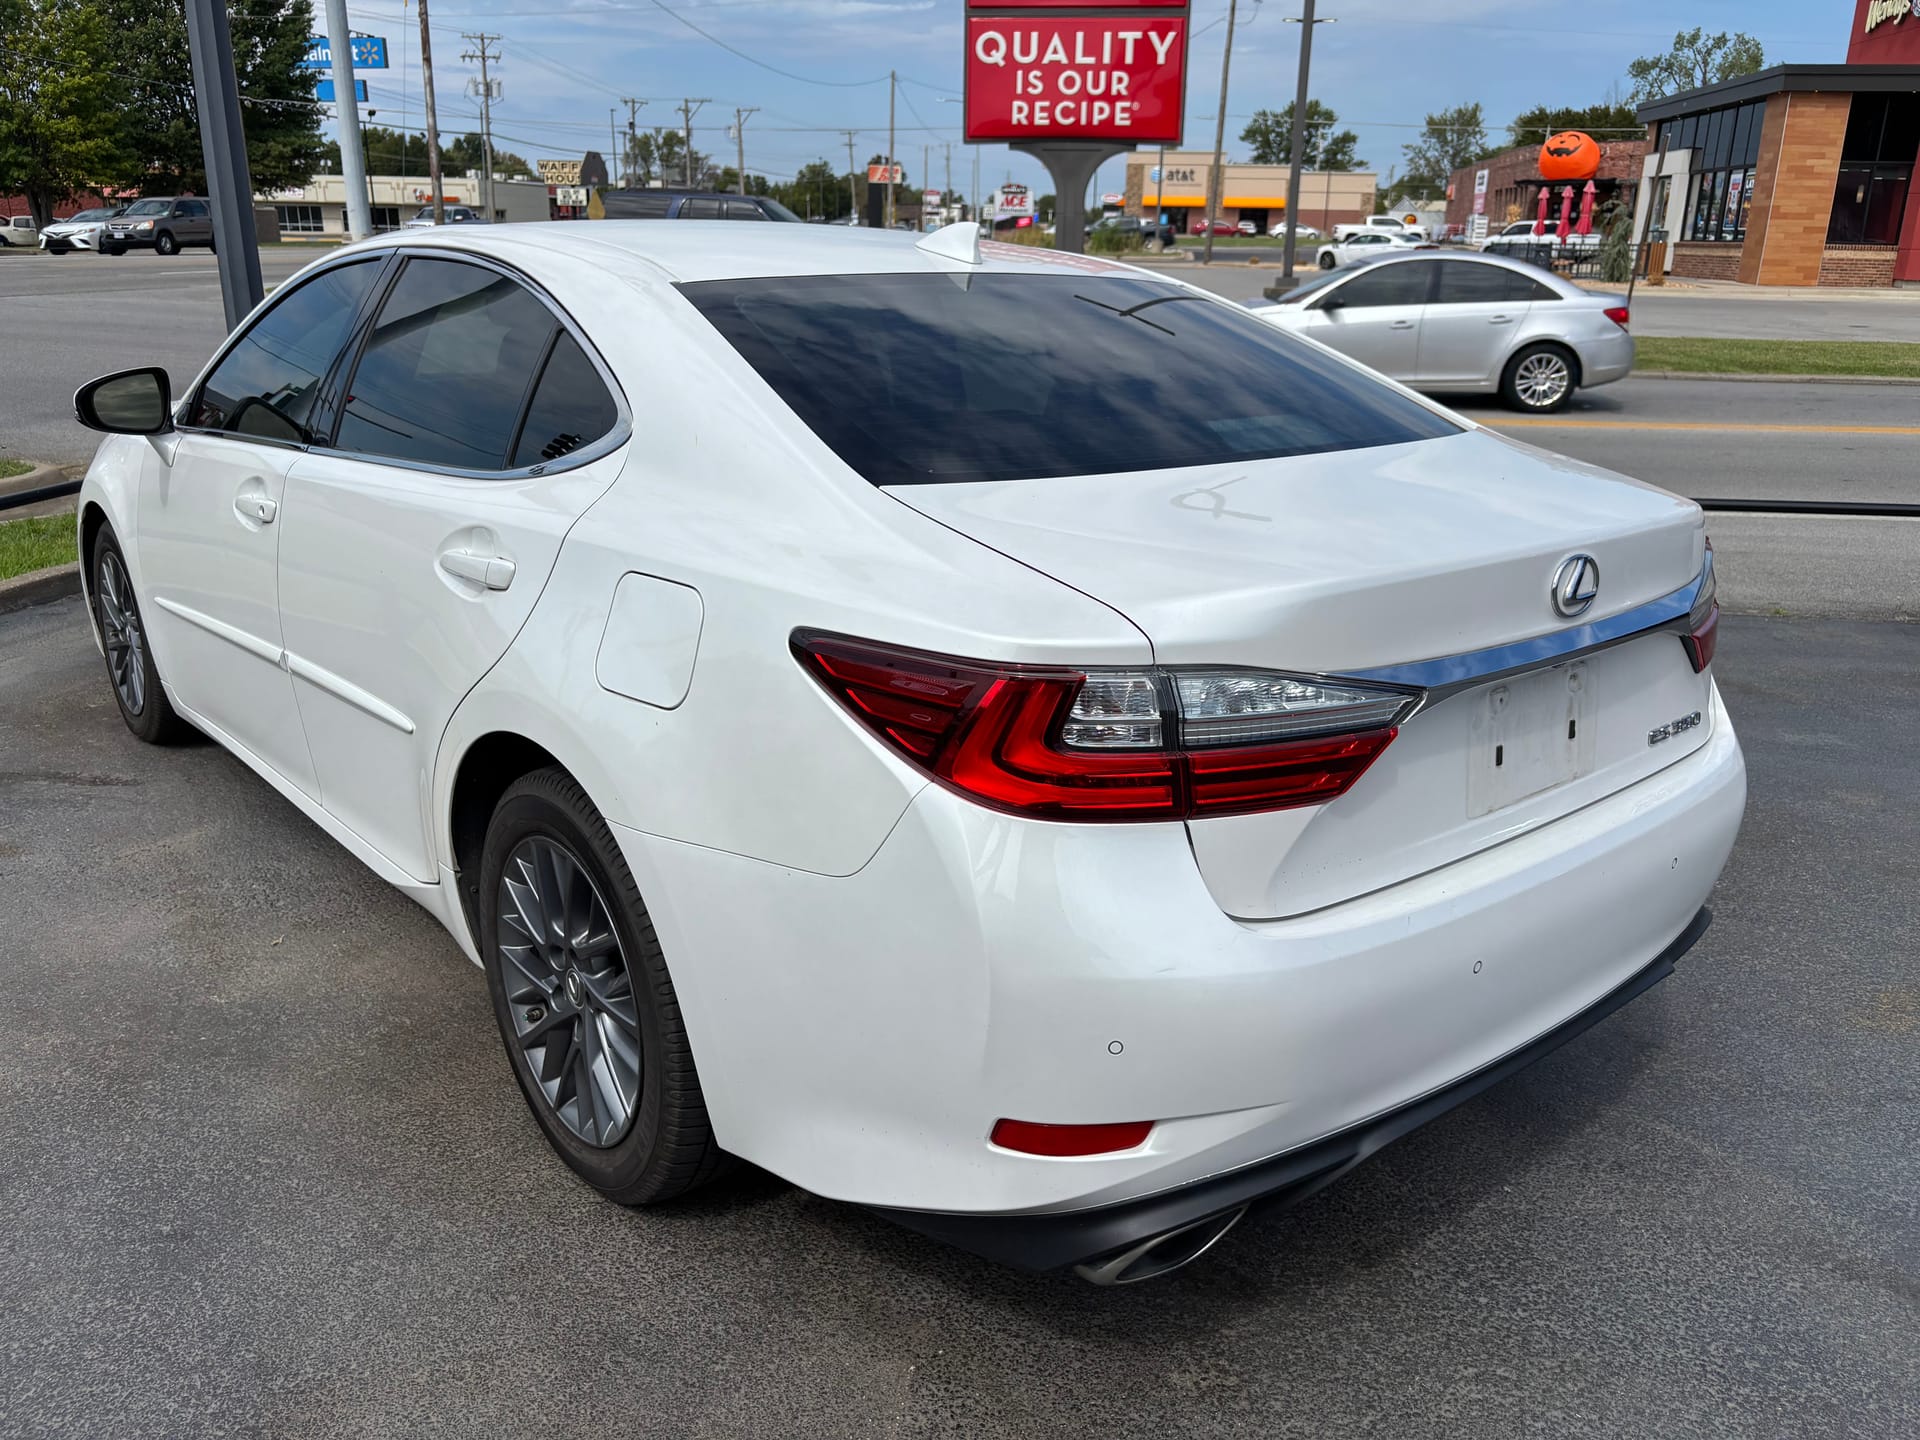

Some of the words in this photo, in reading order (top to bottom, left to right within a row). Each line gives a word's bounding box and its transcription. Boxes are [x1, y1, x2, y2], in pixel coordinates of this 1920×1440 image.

[303, 44, 359, 61] almt
[975, 30, 1177, 67] QUALITY
[1015, 70, 1044, 95] IS
[1057, 70, 1130, 96] OUR
[539, 162, 578, 171] WAFF
[545, 174, 581, 183] HOU
[1000, 194, 1028, 207] ACE
